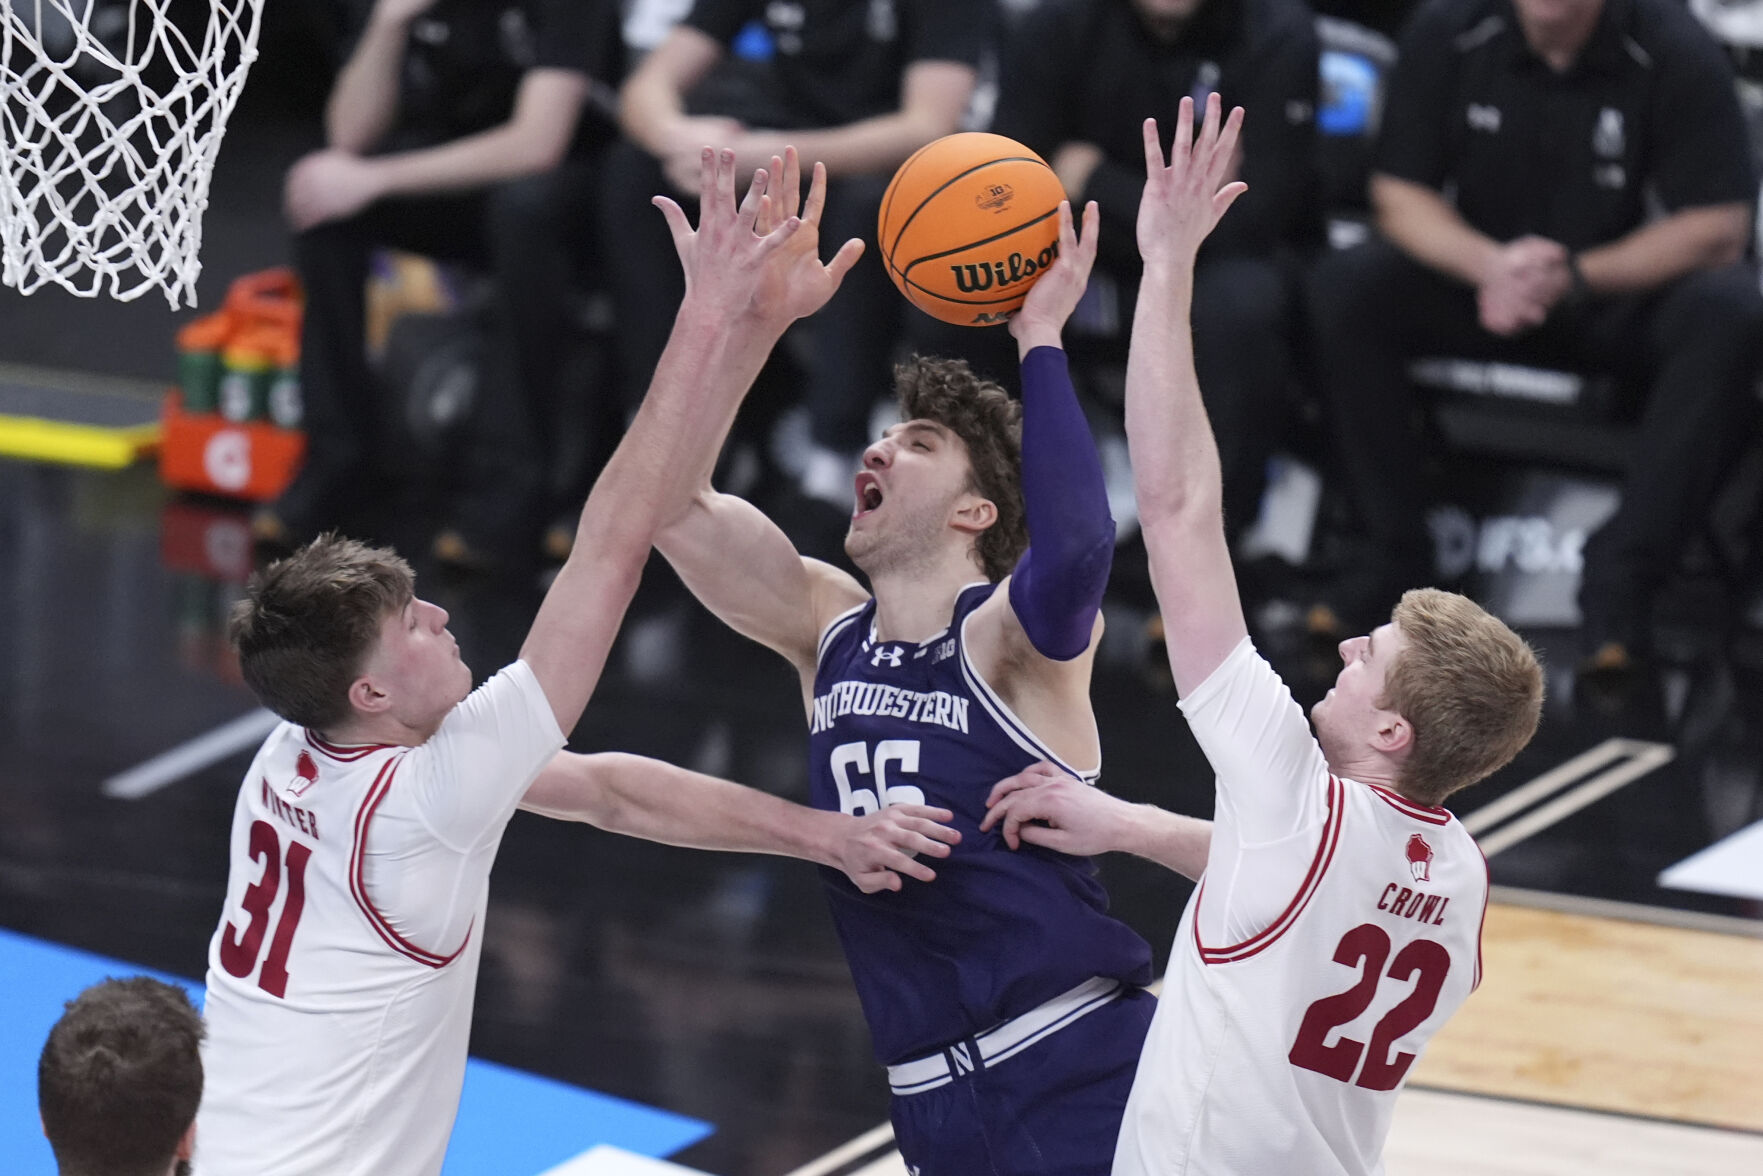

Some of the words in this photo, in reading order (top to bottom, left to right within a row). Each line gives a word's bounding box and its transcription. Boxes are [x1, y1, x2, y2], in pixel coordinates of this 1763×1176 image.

[810, 680, 970, 735] NOTHWESTERN
[219, 819, 313, 999] 31
[1376, 882, 1451, 926] CROWL
[1287, 922, 1452, 1092] 22
[949, 1041, 975, 1077] N
